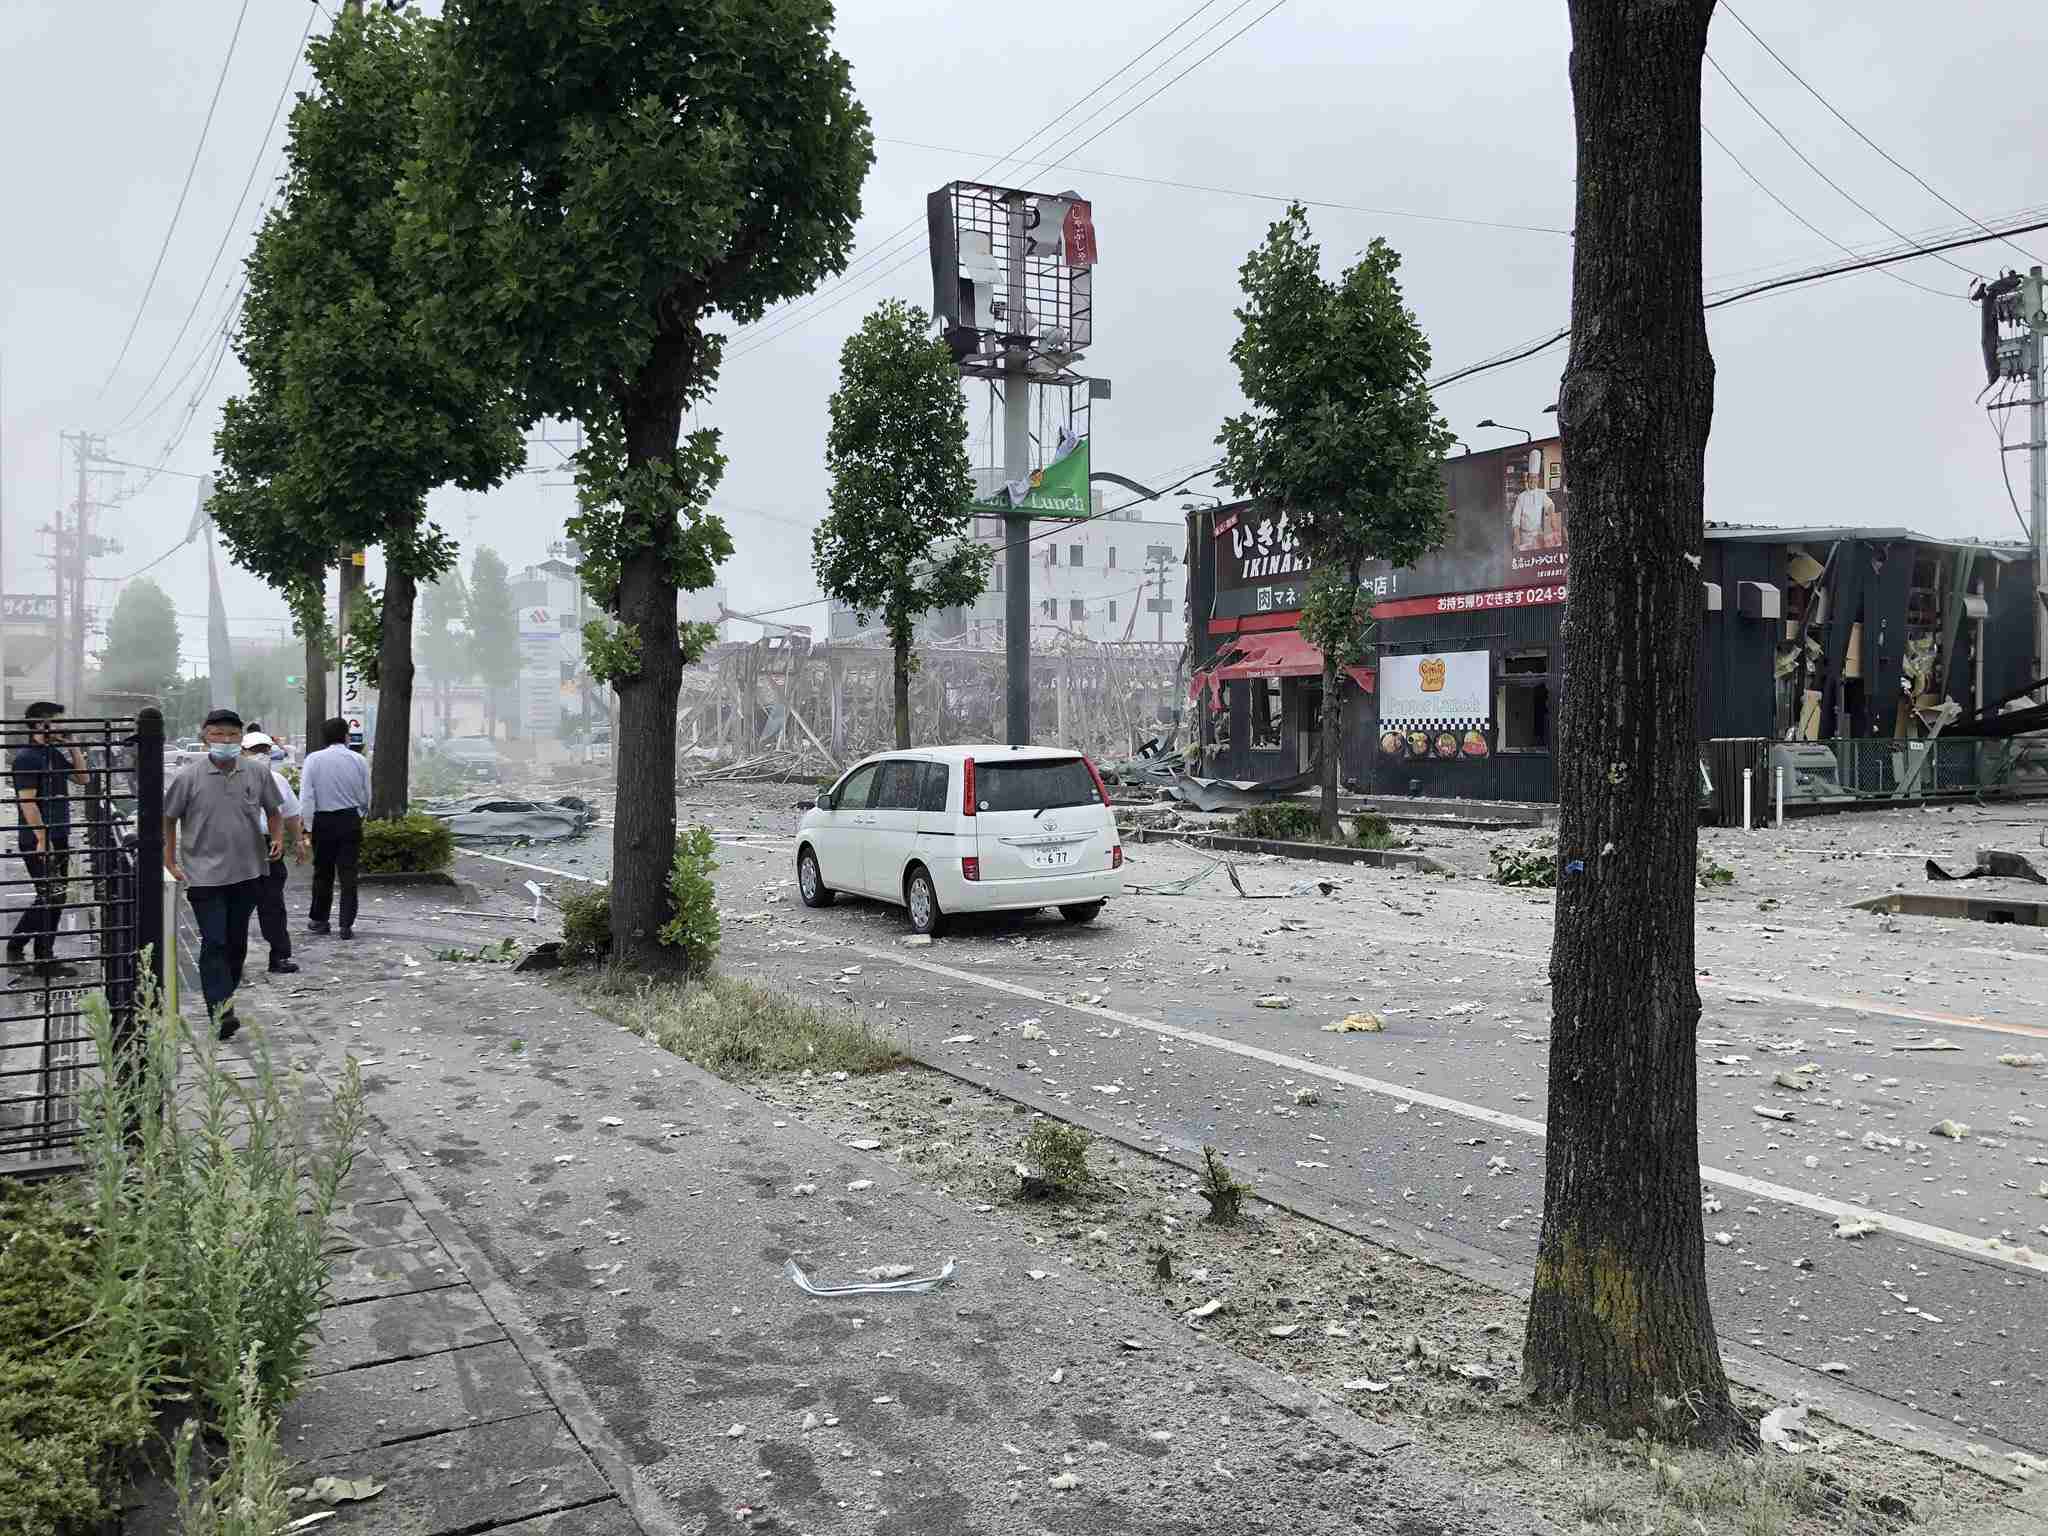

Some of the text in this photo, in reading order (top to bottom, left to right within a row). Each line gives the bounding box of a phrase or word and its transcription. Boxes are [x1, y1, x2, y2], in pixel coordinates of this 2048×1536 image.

[1031, 493, 1085, 511] Lunch
[1438, 590, 1524, 610] お持ち帰りできます
